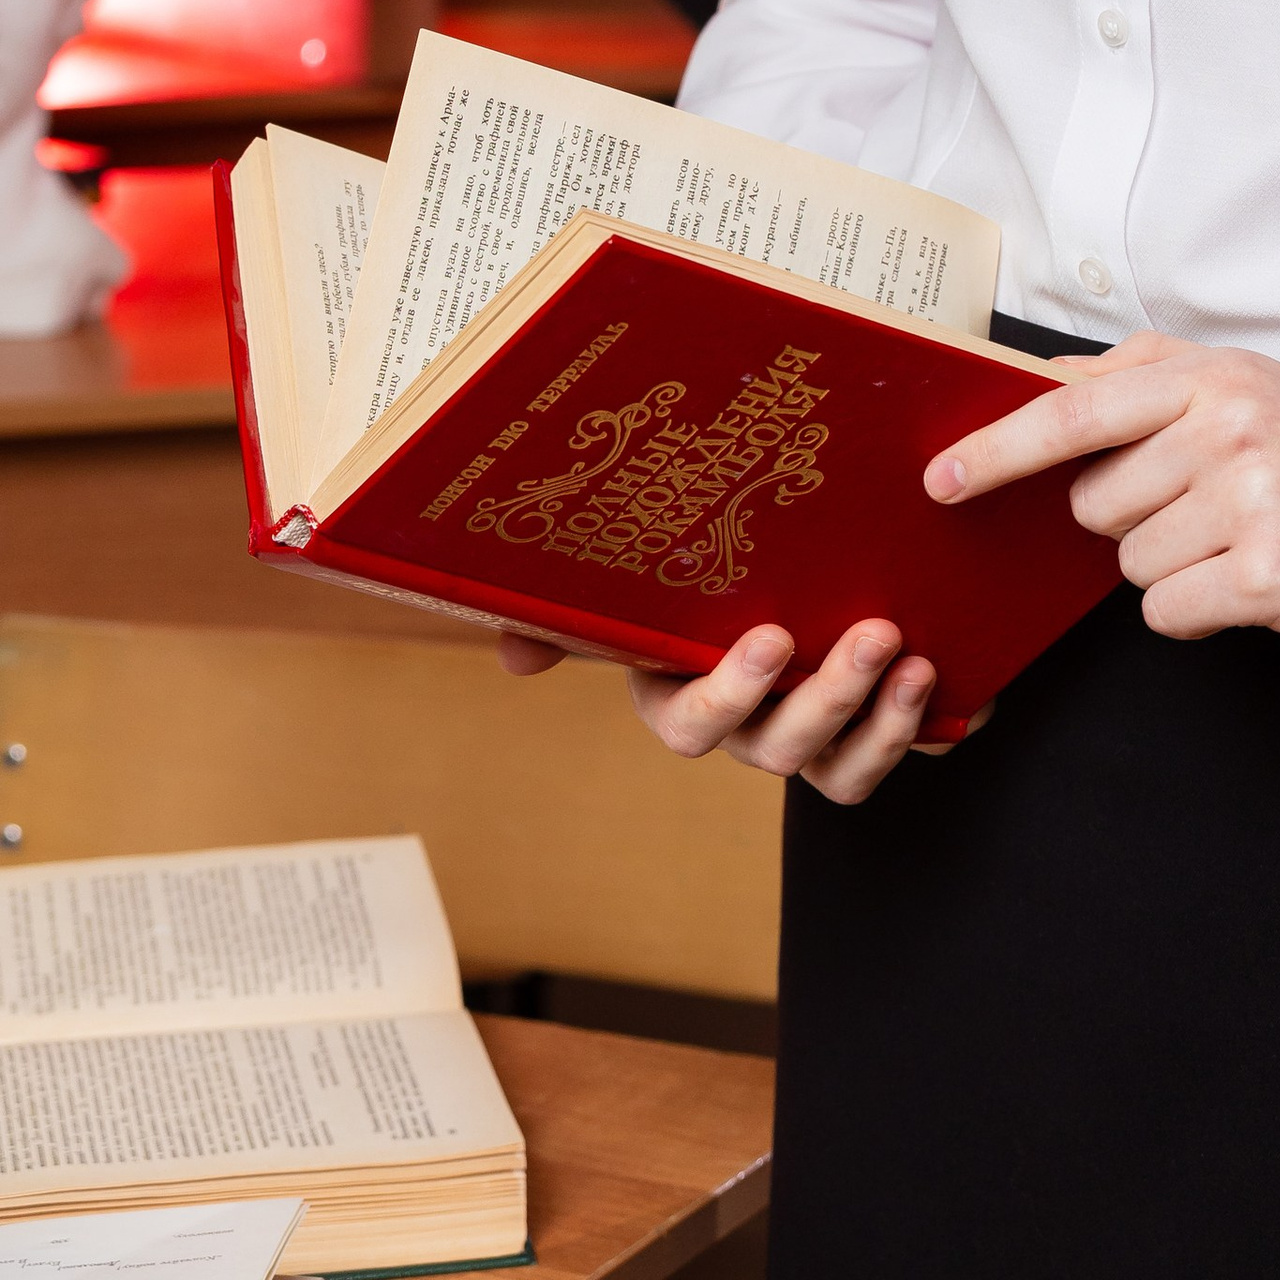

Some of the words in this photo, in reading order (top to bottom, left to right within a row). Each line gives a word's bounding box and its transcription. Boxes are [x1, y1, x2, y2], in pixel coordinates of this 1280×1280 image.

[439, 85, 455, 125] Арма-
[485, 101, 506, 161] графиней
[506, 105, 519, 133] свой
[437, 129, 446, 137] к
[570, 124, 581, 145] сел
[570, 173, 582, 191] Он
[579, 128, 593, 163] хотел
[615, 139, 630, 169] граф
[343, 179, 352, 197] эту
[424, 141, 444, 192] записку
[482, 168, 489, 176] с
[486, 139, 510, 214] переменила
[504, 240, 515, 250] и,
[510, 167, 532, 229] одевшись,
[527, 113, 544, 155] велела
[554, 152, 576, 204] Парижа,
[584, 186, 592, 194] и
[588, 133, 607, 178] узнать,
[592, 182, 605, 211] ится
[601, 134, 617, 176] время!
[609, 174, 620, 194] где
[622, 143, 640, 194] доктора
[698, 167, 714, 206] другу,
[355, 184, 365, 215] теперь
[416, 196, 429, 221] нам
[427, 289, 448, 347] опустила
[444, 242, 459, 278] вуаль
[455, 217, 465, 232] на
[461, 174, 476, 208] лицо,
[471, 133, 484, 162] чтоб
[481, 97, 494, 126] хоть
[467, 182, 486, 238] сходство
[479, 279, 490, 302] она
[486, 263, 494, 271] в
[490, 228, 503, 255] свое
[499, 108, 531, 219] продолжительное
[535, 182, 554, 235] графиня
[551, 210, 561, 226] до
[604, 199, 616, 215] оз,
[666, 199, 680, 235] евять
[675, 158, 689, 192] часов
[678, 212, 691, 238] ову,
[686, 162, 700, 205] данно-
[714, 199, 732, 245] учтиво,
[727, 173, 736, 188] но
[725, 229, 737, 252] оем
[732, 177, 748, 221] приеме
[335, 204, 348, 248] графини.
[346, 204, 360, 257] придумала
[359, 220, 367, 231] то
[382, 371, 400, 411] ргацу
[395, 353, 405, 364] и,
[400, 308, 415, 344] отдав
[411, 287, 420, 301] ее
[416, 237, 434, 281] лакею,
[428, 162, 451, 228] приказала
[446, 113, 463, 154] тотчас
[458, 89, 469, 107] же
[472, 221, 492, 272] сестрой,
[761, 189, 782, 264] ккуратен,—
[787, 197, 807, 255] кабинета,
[826, 206, 839, 246] прого-
[844, 214, 863, 277] покойного
[314, 242, 326, 275] здесь?
[339, 252, 352, 282] губам
[399, 225, 422, 293] известную
[469, 277, 477, 285] с
[874, 272, 886, 303] амке
[880, 226, 898, 266] Го-Па,
[890, 228, 907, 282] сделался
[911, 287, 917, 295] я
[918, 235, 928, 258] вам
[918, 240, 938, 312] приходили?
[930, 242, 948, 306] некоторые
[320, 279, 332, 315] видели
[331, 269, 343, 311] Ребекка.
[345, 286, 353, 299] по
[391, 297, 404, 323] уже
[444, 245, 471, 334] удивительное
[458, 290, 474, 329] вшись
[325, 320, 334, 335] вы
[375, 327, 396, 387] написала
[364, 392, 380, 434] ккара
[420, 454, 495, 520] ПОНСОН
[488, 421, 528, 450] ДЮ
[577, 345, 821, 565] ПОХОЖДЕНИЯ
[610, 381, 829, 574] РОКАМБОЛЯ
[542, 410, 698, 555] ПОЛНЫЕ
